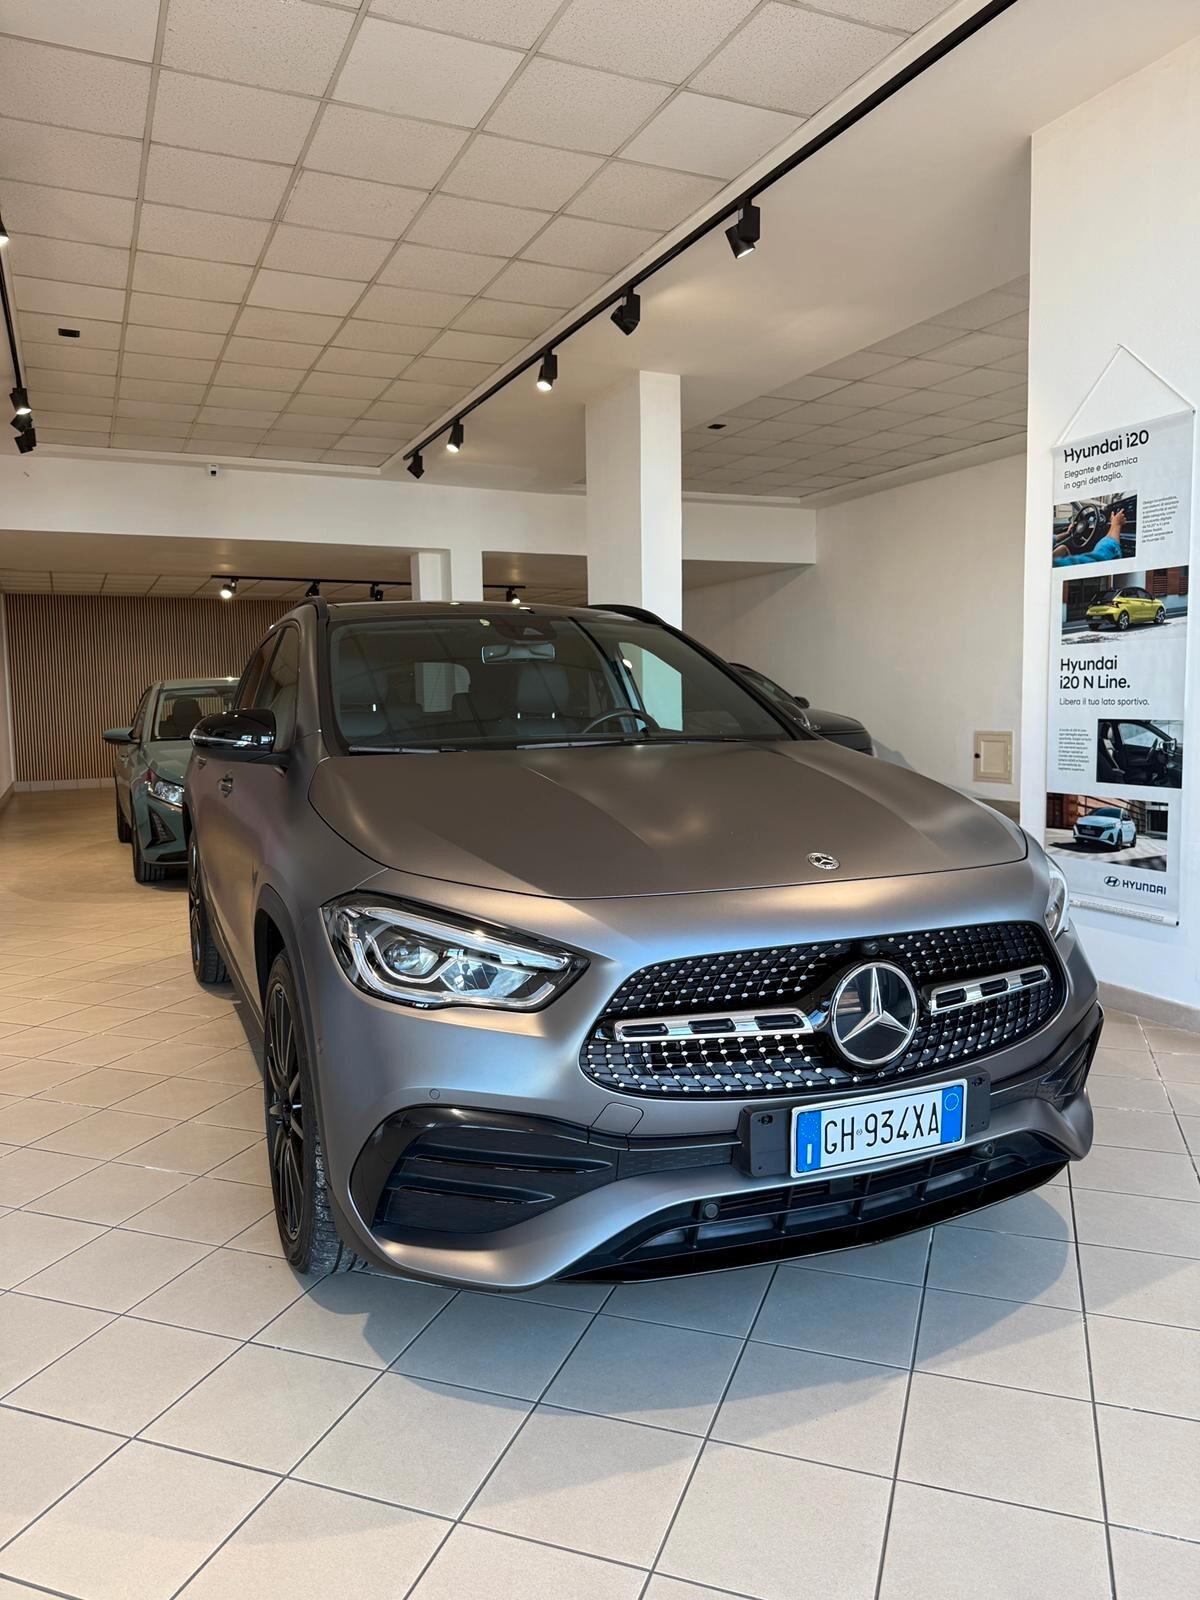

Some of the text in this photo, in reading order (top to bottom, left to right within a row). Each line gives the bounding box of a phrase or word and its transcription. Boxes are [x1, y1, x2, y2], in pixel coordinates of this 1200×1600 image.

[1063, 429, 1150, 464] Hyundai i20
[1064, 463, 1095, 479] Elegante
[1102, 456, 1138, 470] dinamica
[1063, 471, 1123, 490] in ogni dettaglio.
[1060, 655, 1118, 674] Hyundai
[1060, 674, 1131, 689] i20 N Line.
[1059, 698, 1081, 706] Libera
[1088, 698, 1100, 706] tuo
[1101, 698, 1116, 706] lato
[1117, 697, 1150, 707] sportivo.
[1122, 879, 1167, 895] HYUNDAI
[824, 1116, 855, 1155] GH
[864, 1102, 940, 1148] 934XA
